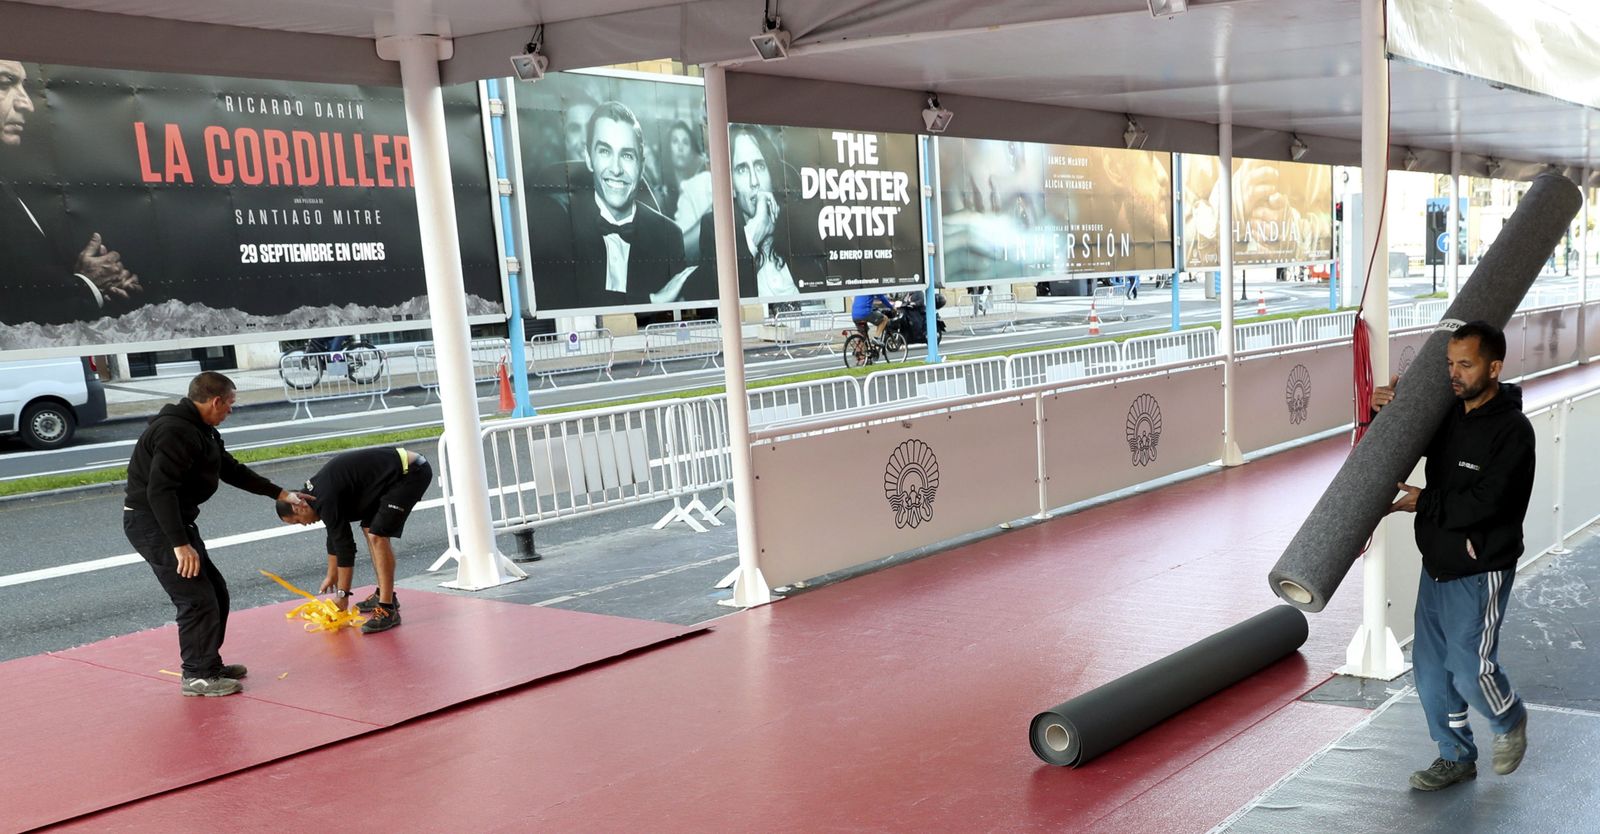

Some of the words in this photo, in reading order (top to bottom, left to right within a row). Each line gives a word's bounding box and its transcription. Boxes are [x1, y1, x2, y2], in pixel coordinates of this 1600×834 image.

[224, 95, 304, 117] RICARDO
[314, 101, 364, 120] DARÍN
[134, 121, 194, 183] LA
[203, 124, 416, 187] CORDILLER
[831, 131, 879, 168] THE
[1047, 155, 1066, 166] JAMES
[800, 166, 911, 206] DISASTER
[1044, 179, 1064, 189] ALICIA
[234, 209, 323, 225] SANTIAGO
[333, 209, 382, 225] MITRE
[818, 205, 898, 241] ARTIST
[239, 244, 258, 263] 29
[259, 243, 335, 263] SEPTIEMBRE
[335, 242, 351, 261] EN
[351, 242, 385, 261] CINES
[829, 250, 839, 260] 26
[839, 250, 863, 260] ENERO
[864, 250, 874, 260] EN
[874, 249, 893, 259] CINES
[1004, 228, 1130, 261] INMERSIÓN
